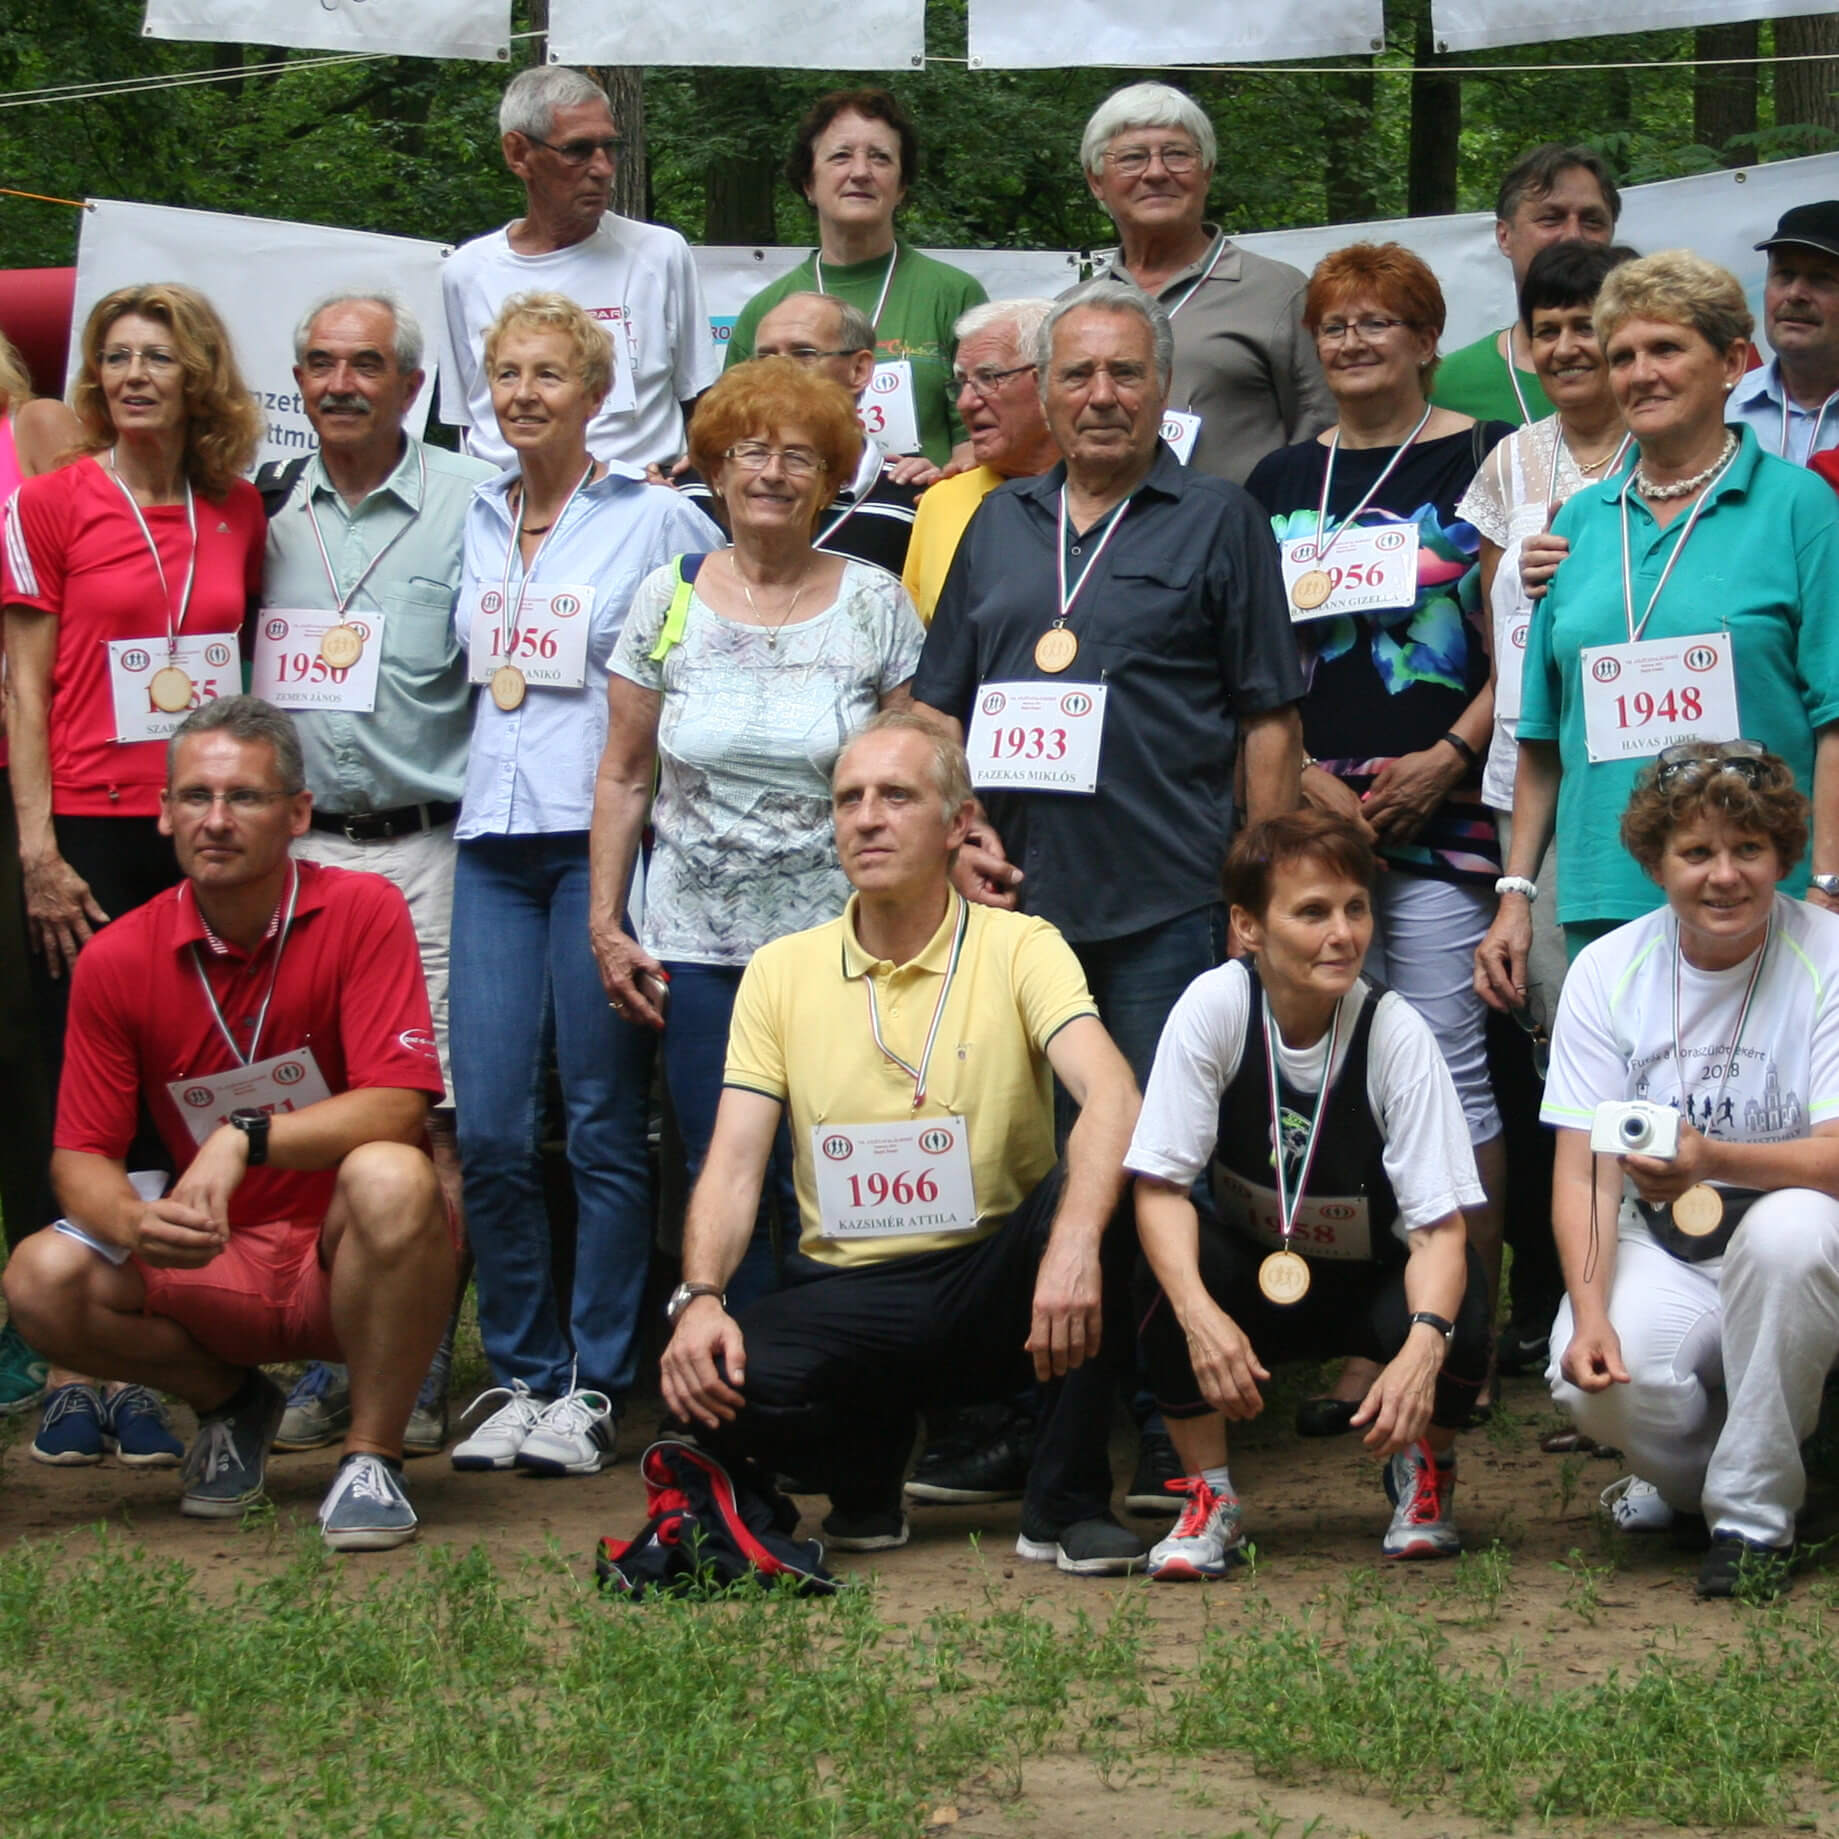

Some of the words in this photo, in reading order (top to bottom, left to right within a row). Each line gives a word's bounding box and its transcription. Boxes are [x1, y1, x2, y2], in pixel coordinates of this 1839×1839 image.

[1614, 686, 1703, 729] 1948
[988, 727, 1067, 761] 1933
[1622, 737, 1661, 751] HAVAS
[978, 769, 1025, 781] FAZEKAS
[1028, 769, 1077, 784] MIKLÓS
[847, 1167, 939, 1208] 1966
[838, 1213, 905, 1231] KAZSIMÉR
[907, 1211, 958, 1226] ATTILA
